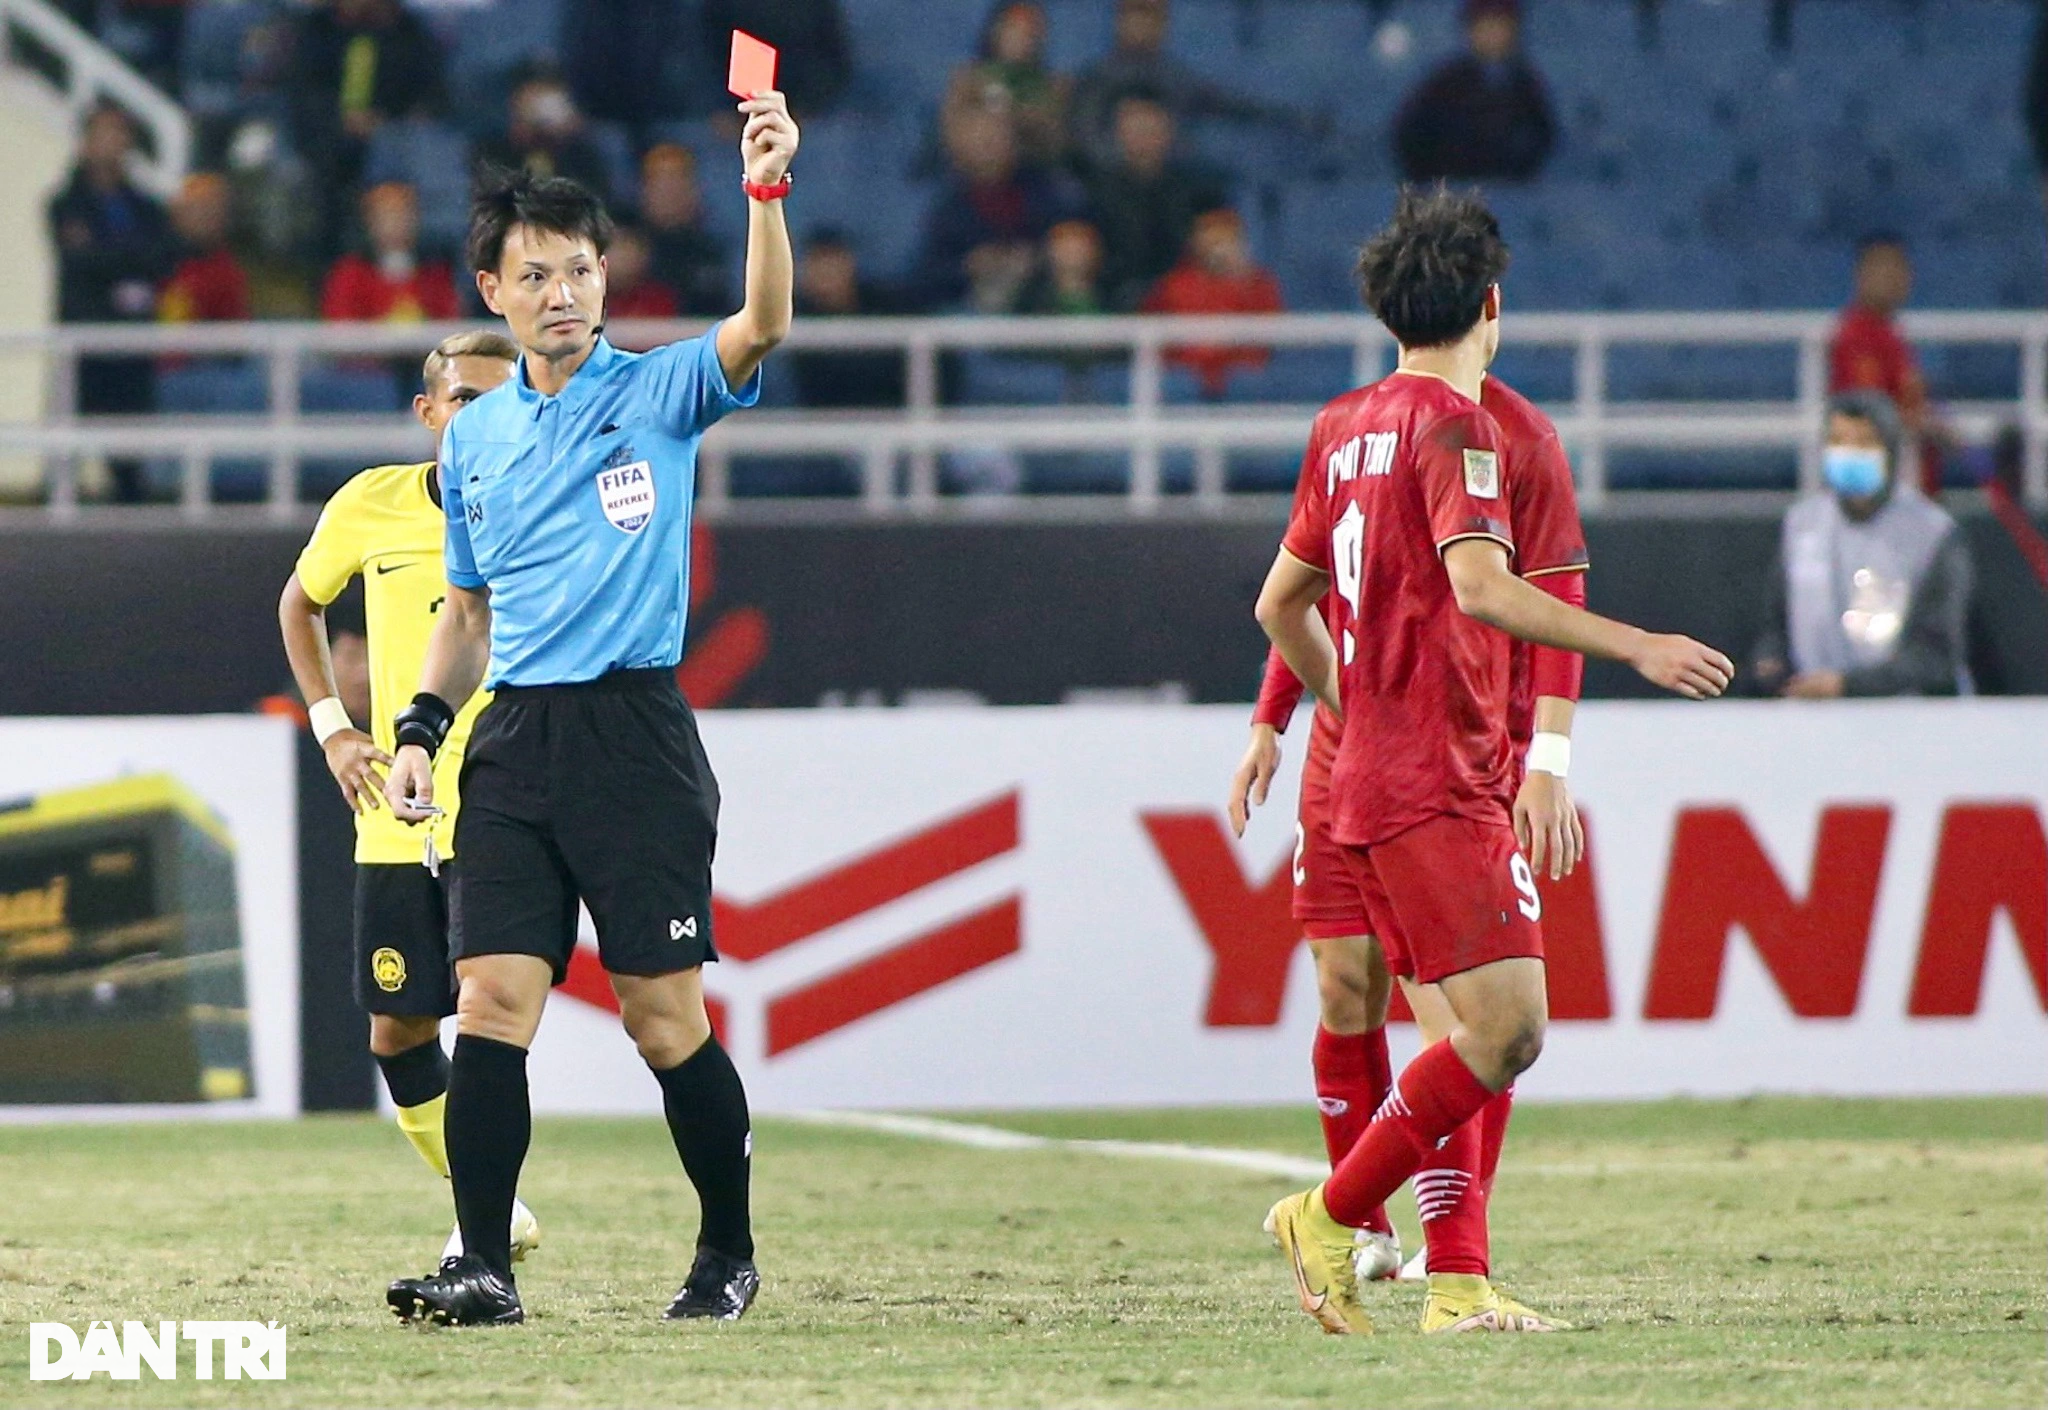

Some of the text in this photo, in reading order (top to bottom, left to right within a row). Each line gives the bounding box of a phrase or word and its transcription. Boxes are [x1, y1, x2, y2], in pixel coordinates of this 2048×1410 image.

[602, 467, 645, 491] FIFA
[608, 492, 649, 510] REFEREE
[1510, 851, 1541, 922] 9
